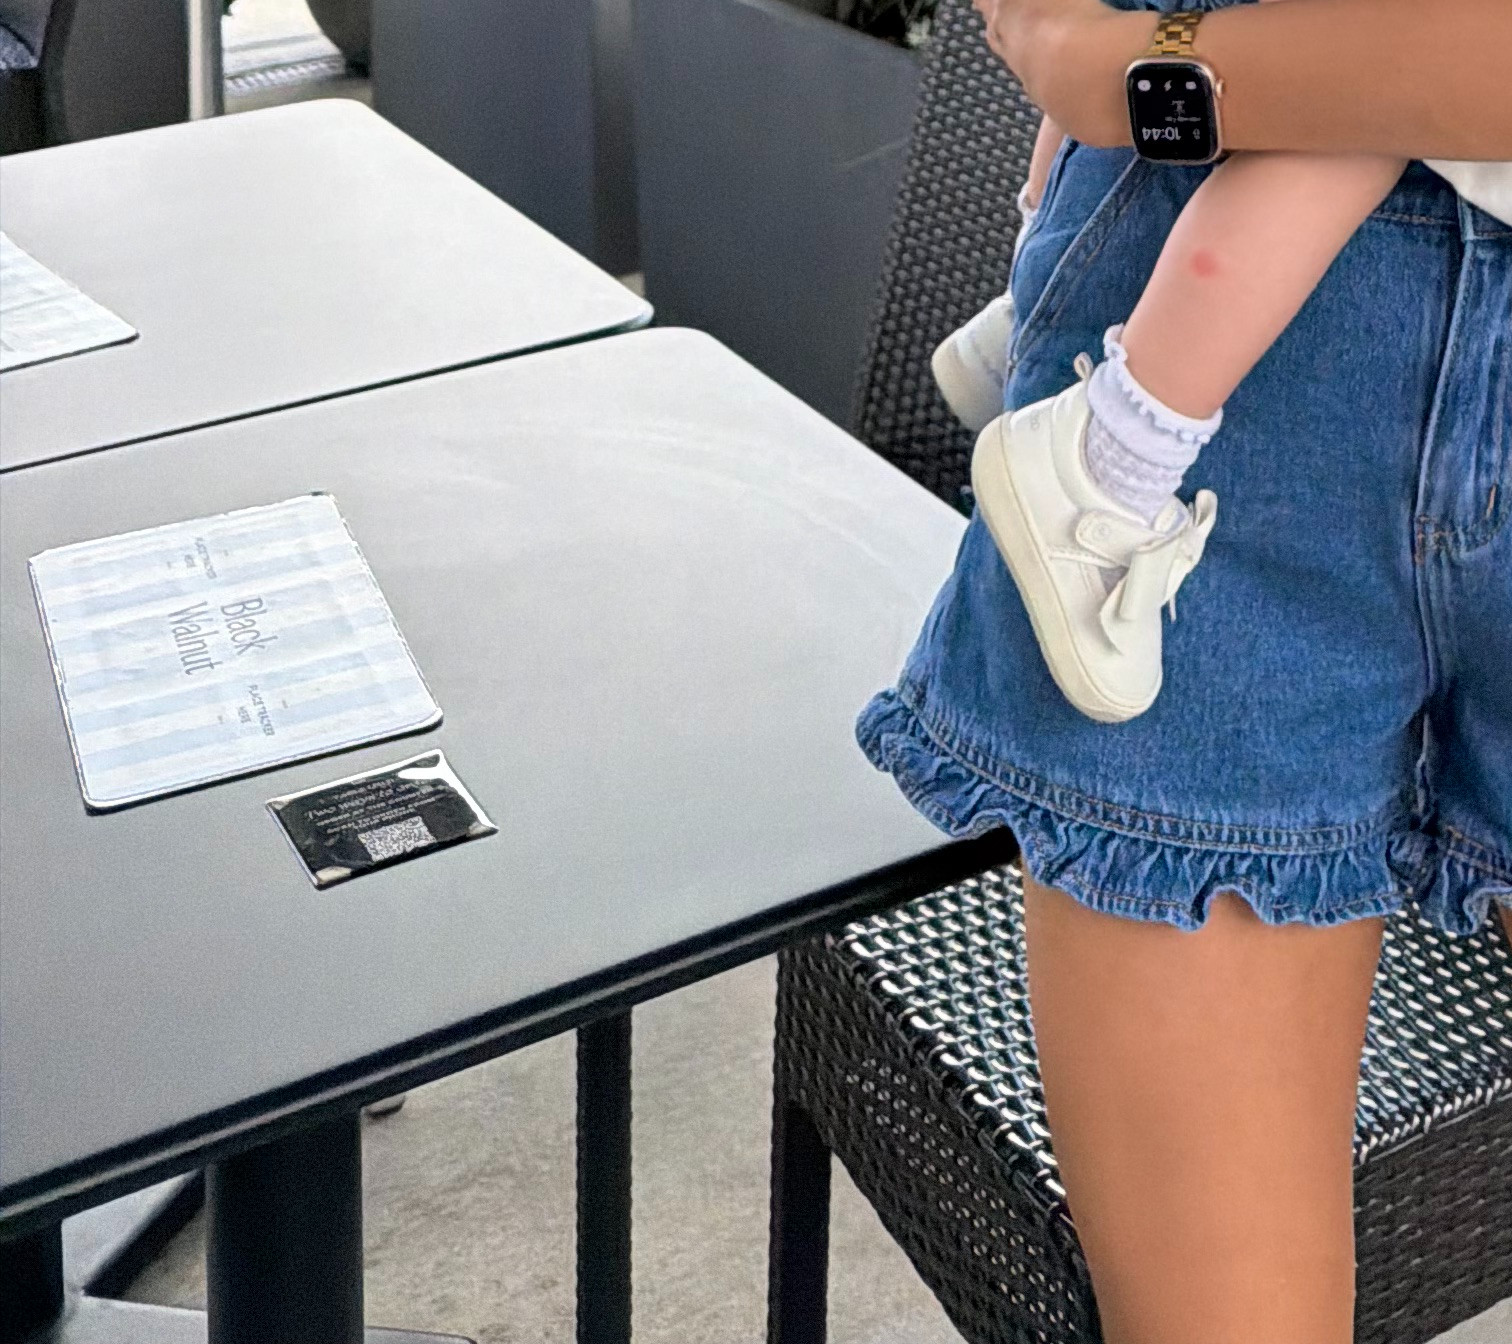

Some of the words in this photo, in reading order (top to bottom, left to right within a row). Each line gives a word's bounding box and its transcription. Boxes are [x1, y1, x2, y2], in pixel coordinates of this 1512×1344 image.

[1142, 126, 1182, 141] 10:44
[167, 600, 223, 675] Walnut
[221, 597, 278, 655] Black
